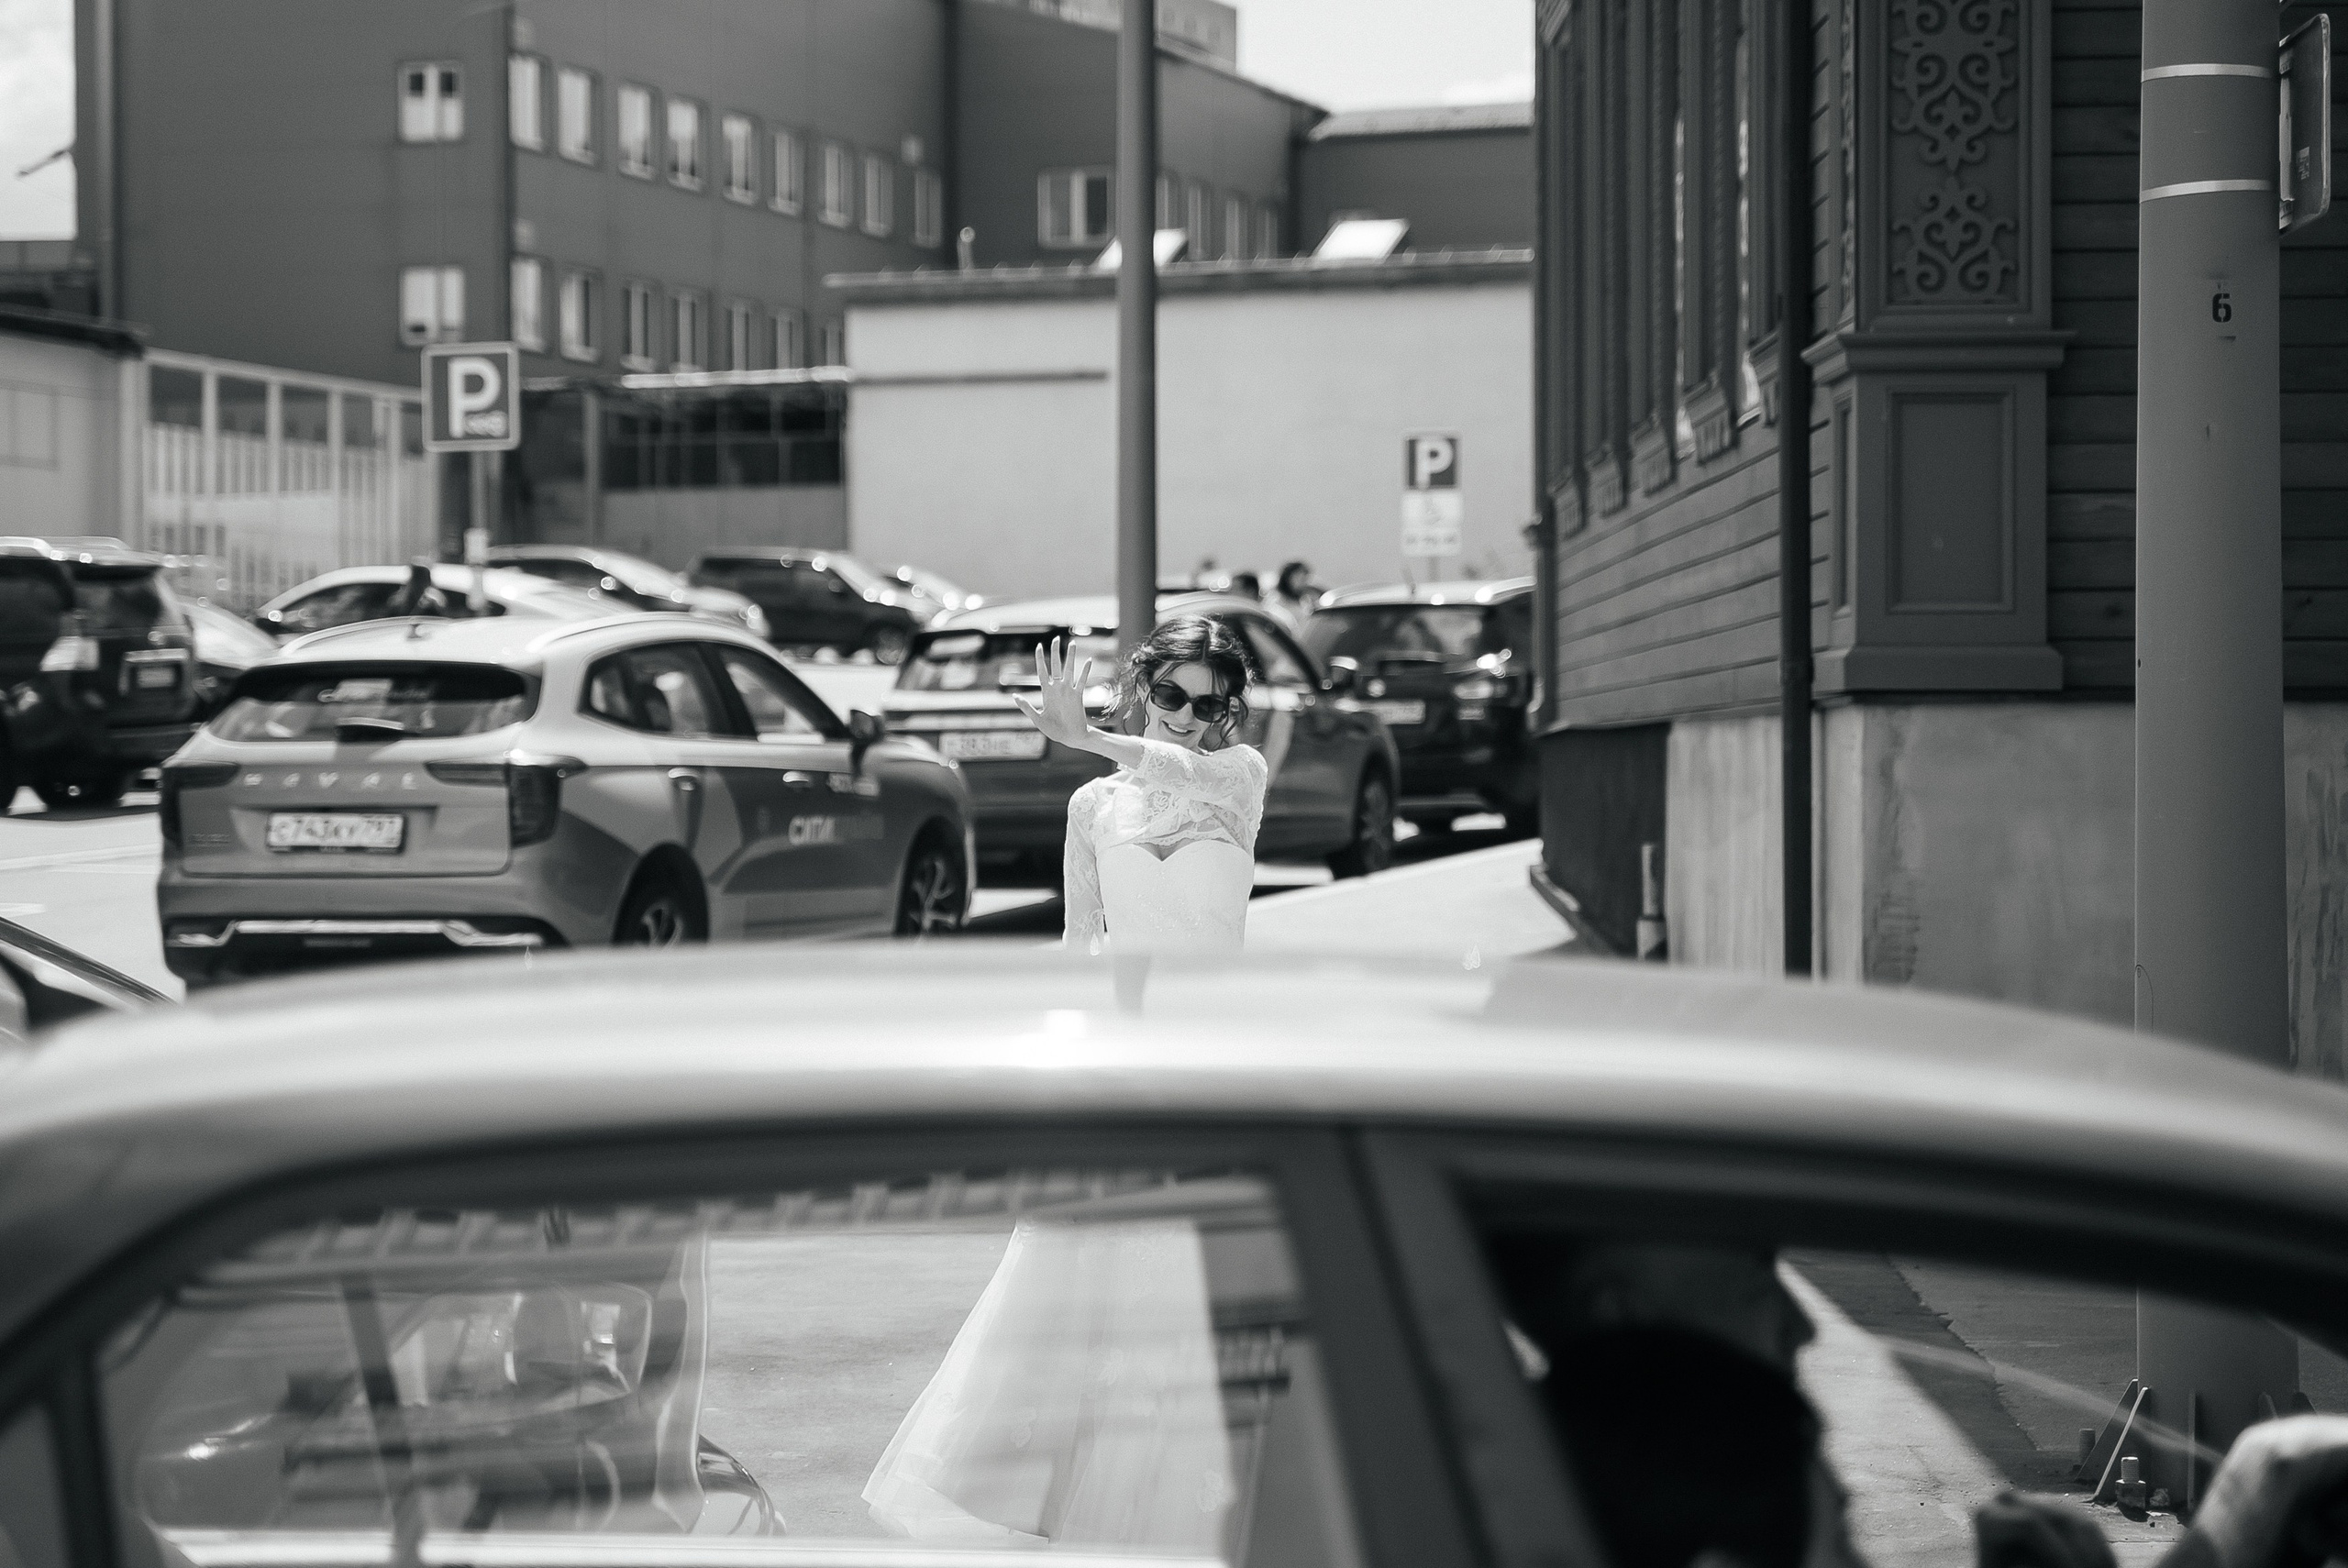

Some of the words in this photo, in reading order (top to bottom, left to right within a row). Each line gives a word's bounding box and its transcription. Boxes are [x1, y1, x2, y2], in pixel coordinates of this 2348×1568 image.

[2212, 293, 2232, 323] 6
[448, 356, 501, 438] P
[1415, 437, 1454, 489] P
